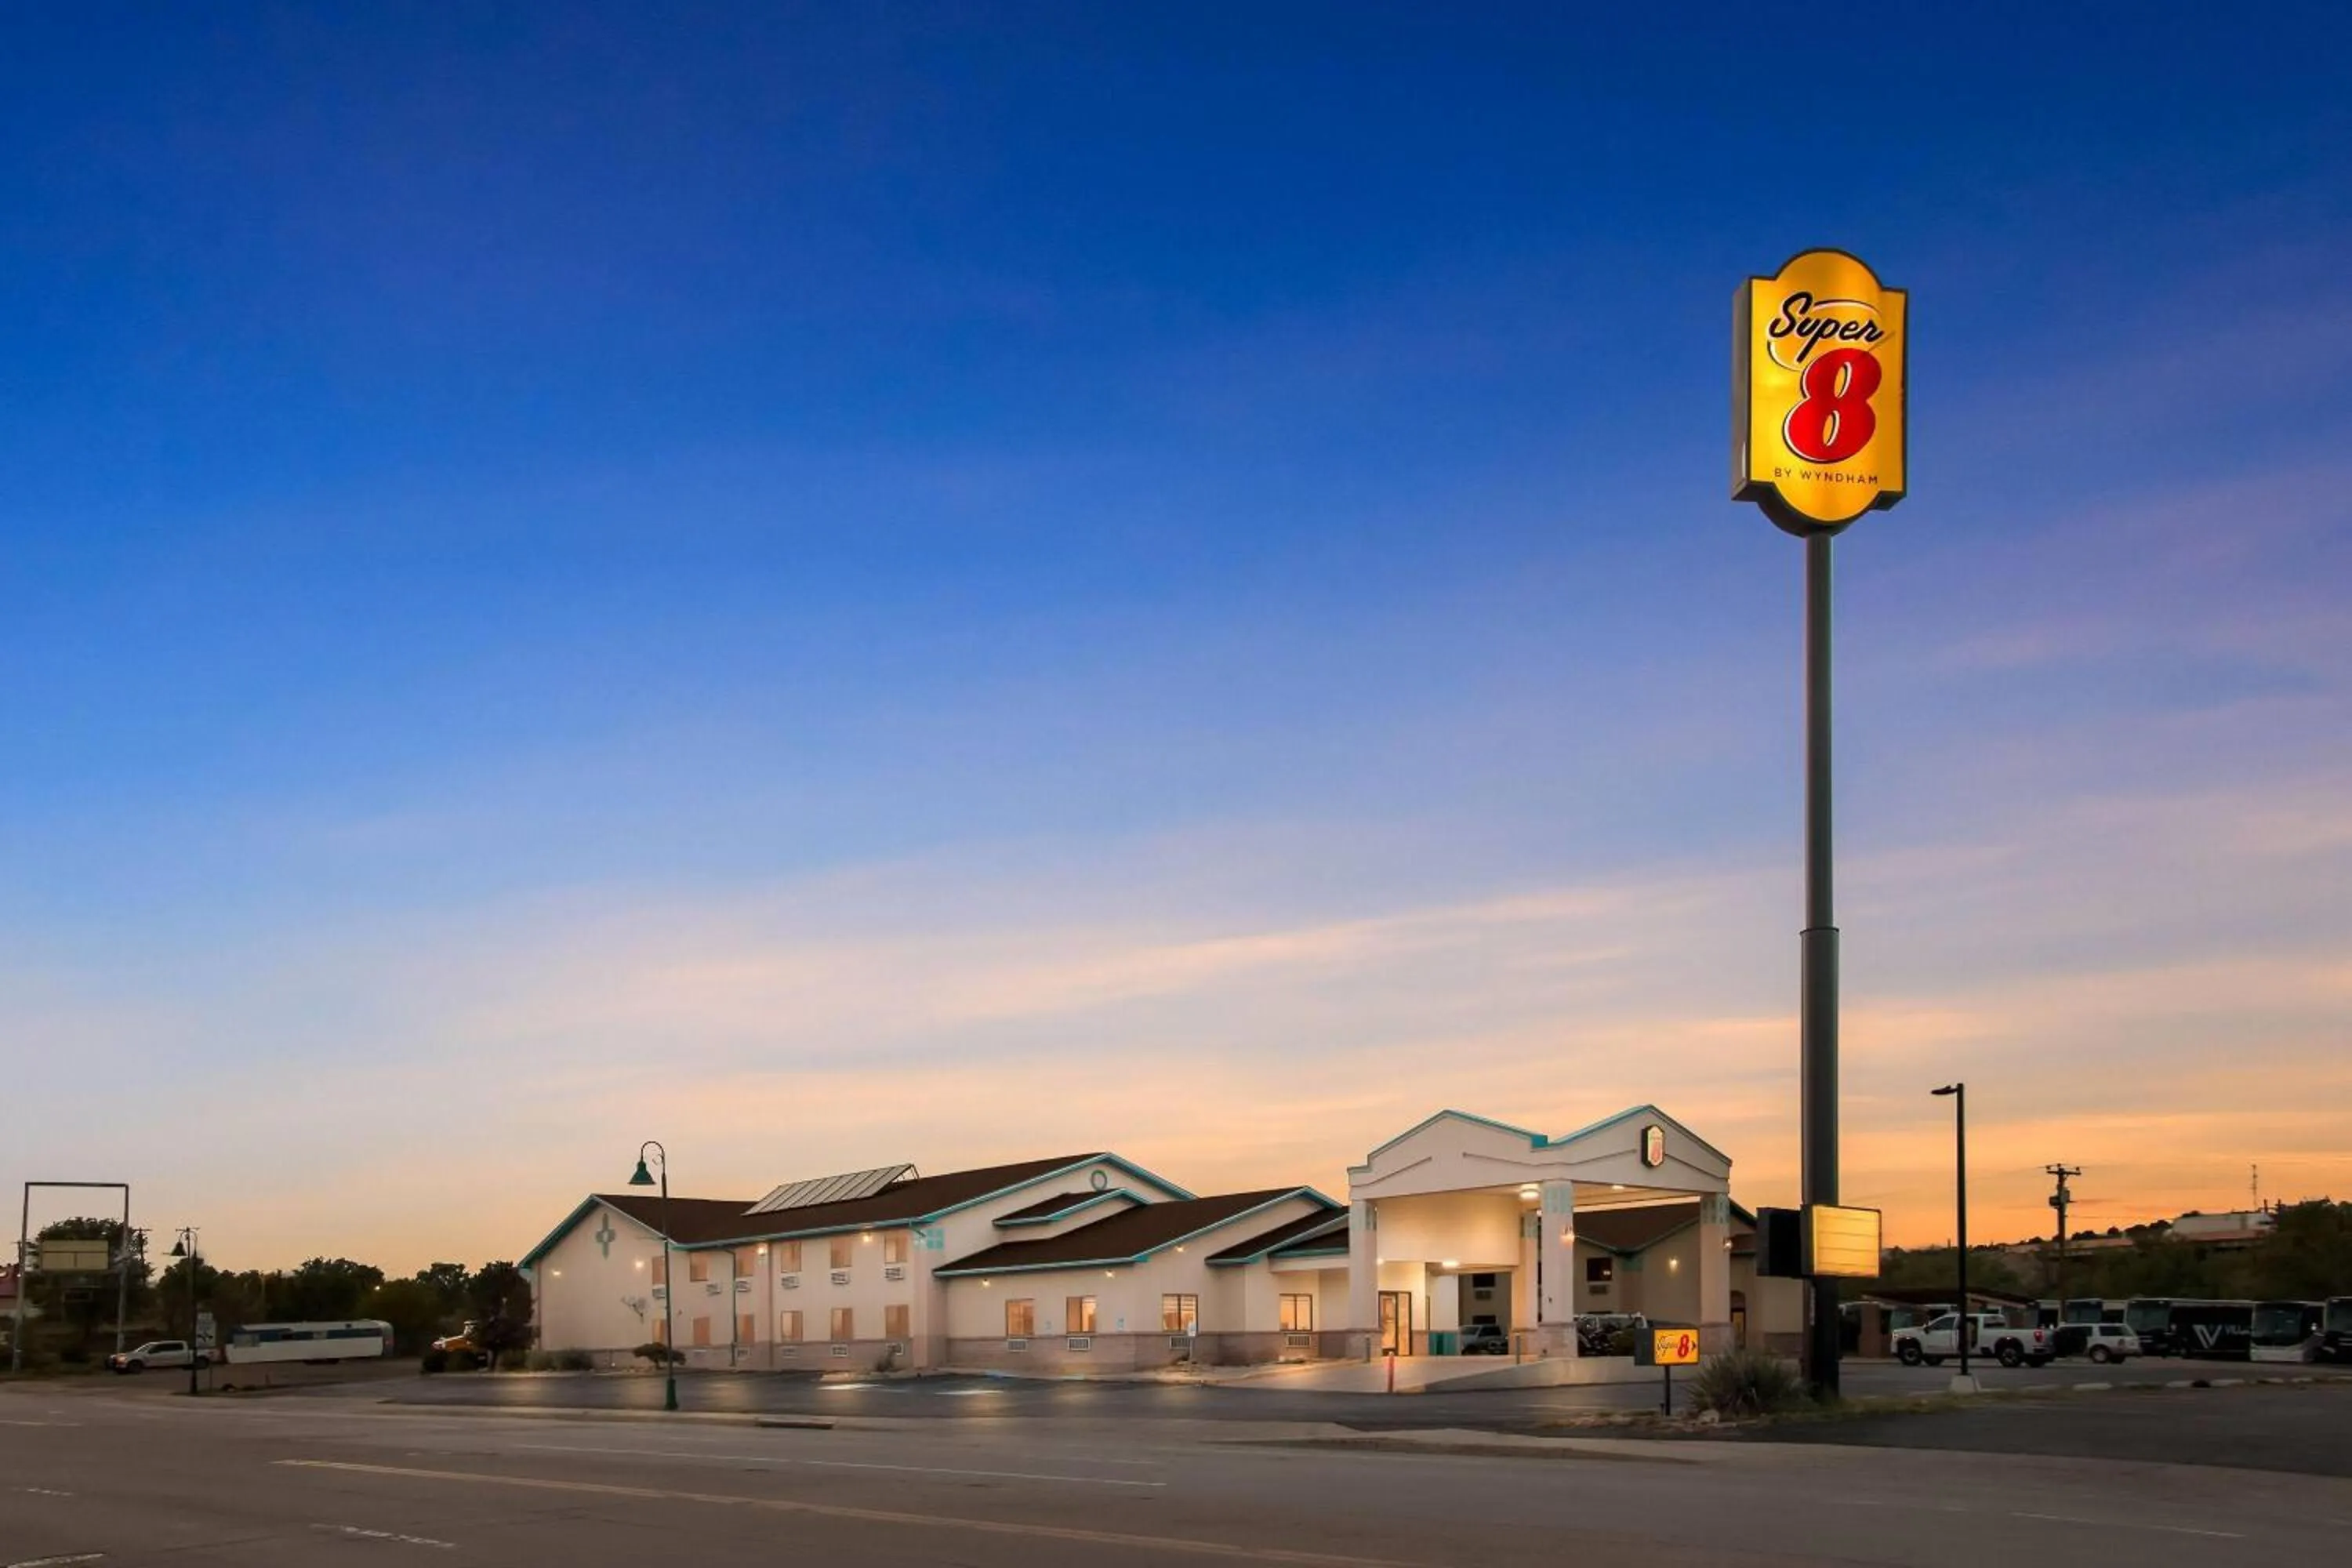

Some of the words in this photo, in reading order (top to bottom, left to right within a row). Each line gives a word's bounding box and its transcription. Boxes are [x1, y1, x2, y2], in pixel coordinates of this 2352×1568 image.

[1768, 291, 1885, 365] Super
[1782, 347, 1882, 464] 8
[1774, 467, 1791, 477] BY
[1801, 470, 1878, 483] WYNDHAM
[1679, 1334, 1690, 1359] 8
